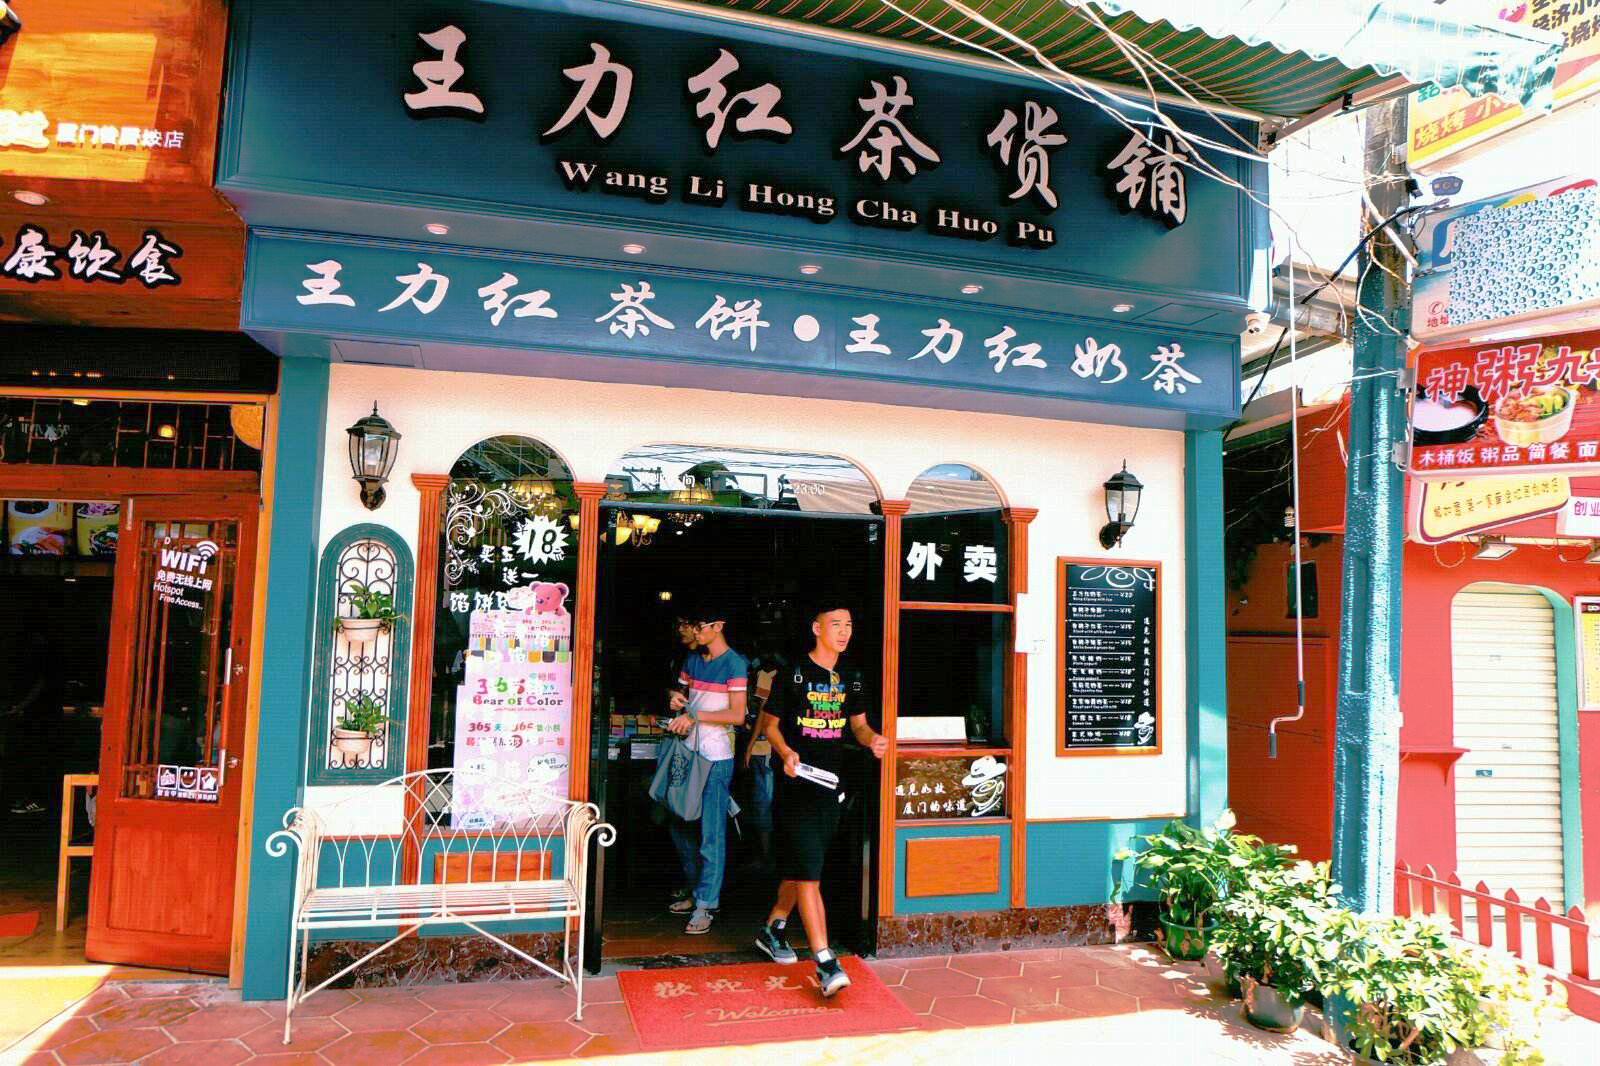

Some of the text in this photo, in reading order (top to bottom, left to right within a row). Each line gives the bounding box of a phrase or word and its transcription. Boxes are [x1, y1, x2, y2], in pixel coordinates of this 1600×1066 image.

[404, 25, 1187, 225] 王力红茶货铺
[561, 161, 1055, 243] Wang Li Hong Cha Huo Pu
[297, 260, 1203, 395] 王力红茶饼 王力红奶茶
[1419, 449, 1475, 467] 木桶饭
[1480, 446, 1521, 464] 粥品
[906, 541, 998, 583] 外卖
[527, 695, 564, 706] Color
